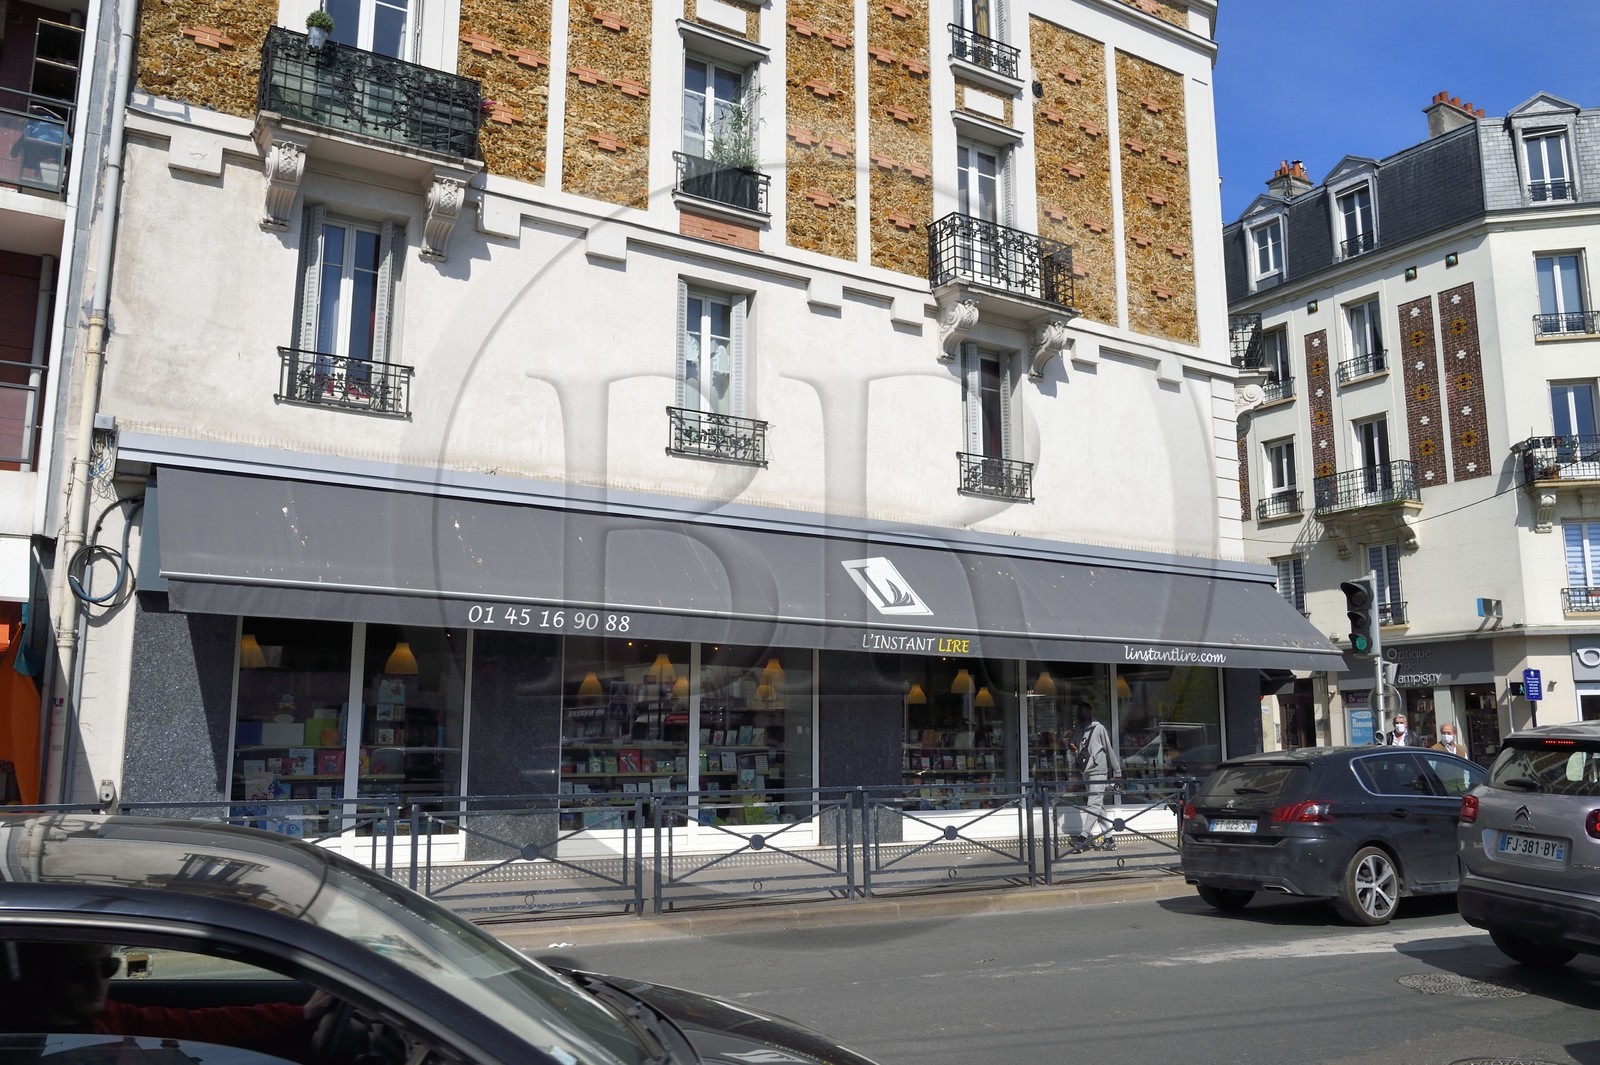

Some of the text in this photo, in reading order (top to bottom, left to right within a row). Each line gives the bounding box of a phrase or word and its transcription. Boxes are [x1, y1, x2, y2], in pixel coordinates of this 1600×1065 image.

[468, 605, 630, 632] 01 45 16 90 88
[862, 633, 970, 653] L'INSTANT LIRE
[1124, 645, 1227, 663] linstantlire.com
[1387, 648, 1432, 661] Optique
[1397, 671, 1442, 685] ampigny
[1506, 836, 1558, 857] FJ-381-BY
